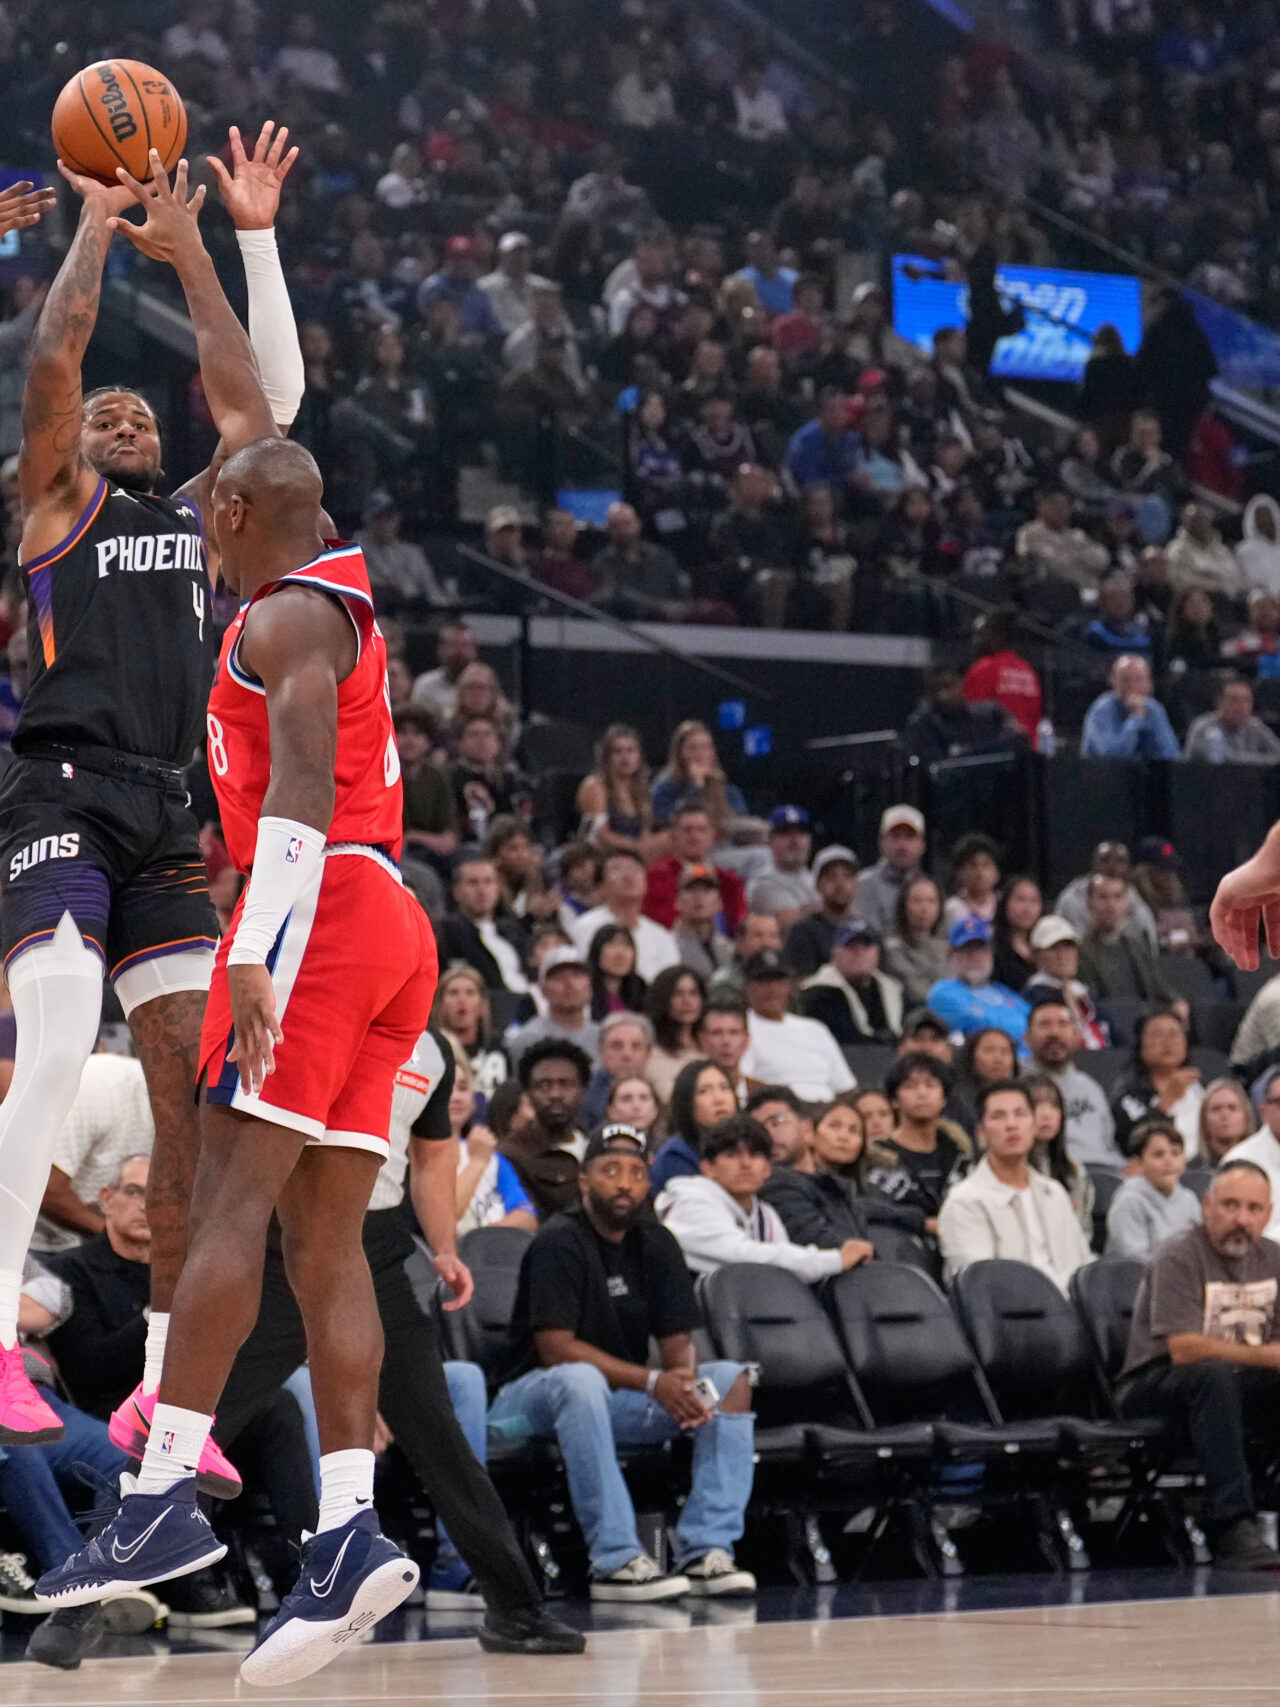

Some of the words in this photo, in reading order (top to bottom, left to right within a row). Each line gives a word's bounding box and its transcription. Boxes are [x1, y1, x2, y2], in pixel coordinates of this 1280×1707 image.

[97, 65, 138, 142] Wilson
[95, 533, 204, 578] PHOENIX
[192, 581, 205, 642] 4
[207, 713, 228, 776] 8
[9, 832, 80, 882] SUNS
